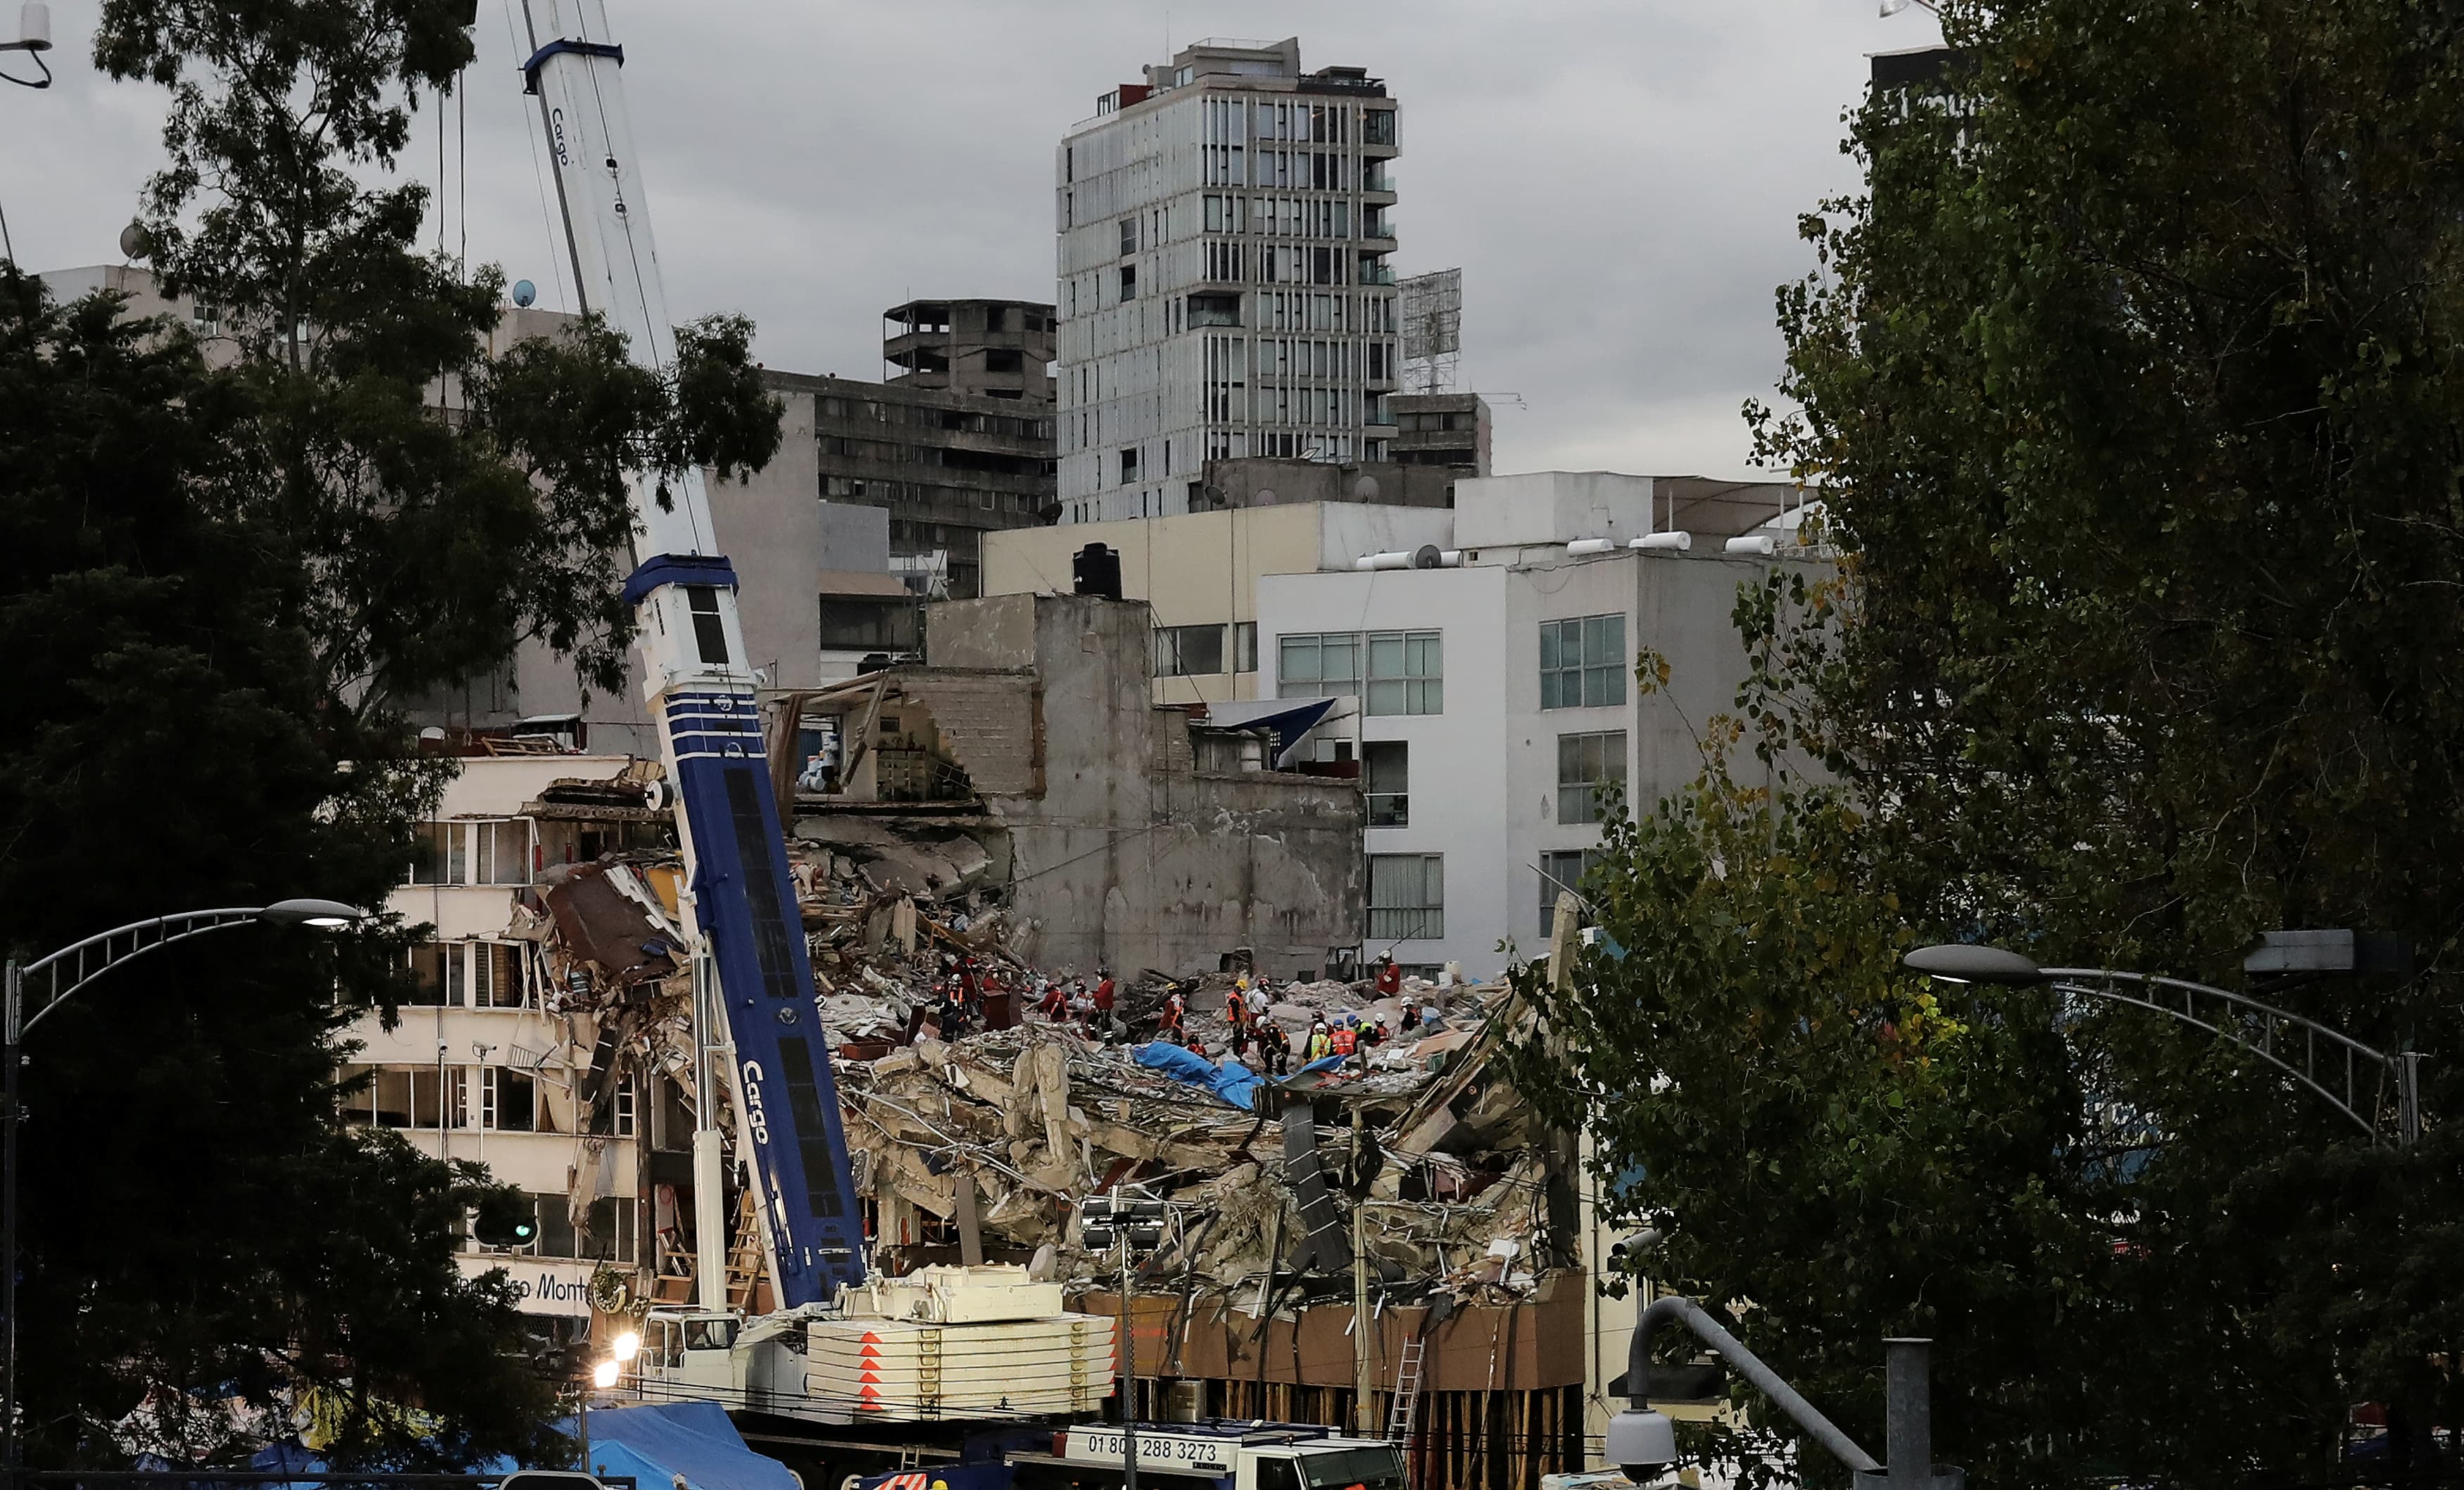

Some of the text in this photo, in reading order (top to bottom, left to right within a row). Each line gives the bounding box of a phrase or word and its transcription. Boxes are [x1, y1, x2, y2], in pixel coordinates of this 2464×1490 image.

[553, 108, 568, 166] Cargo
[743, 1060, 769, 1145] Cargo
[537, 1273, 593, 1301] Mont
[1088, 1435, 1217, 1462] 01 80 288 3273
